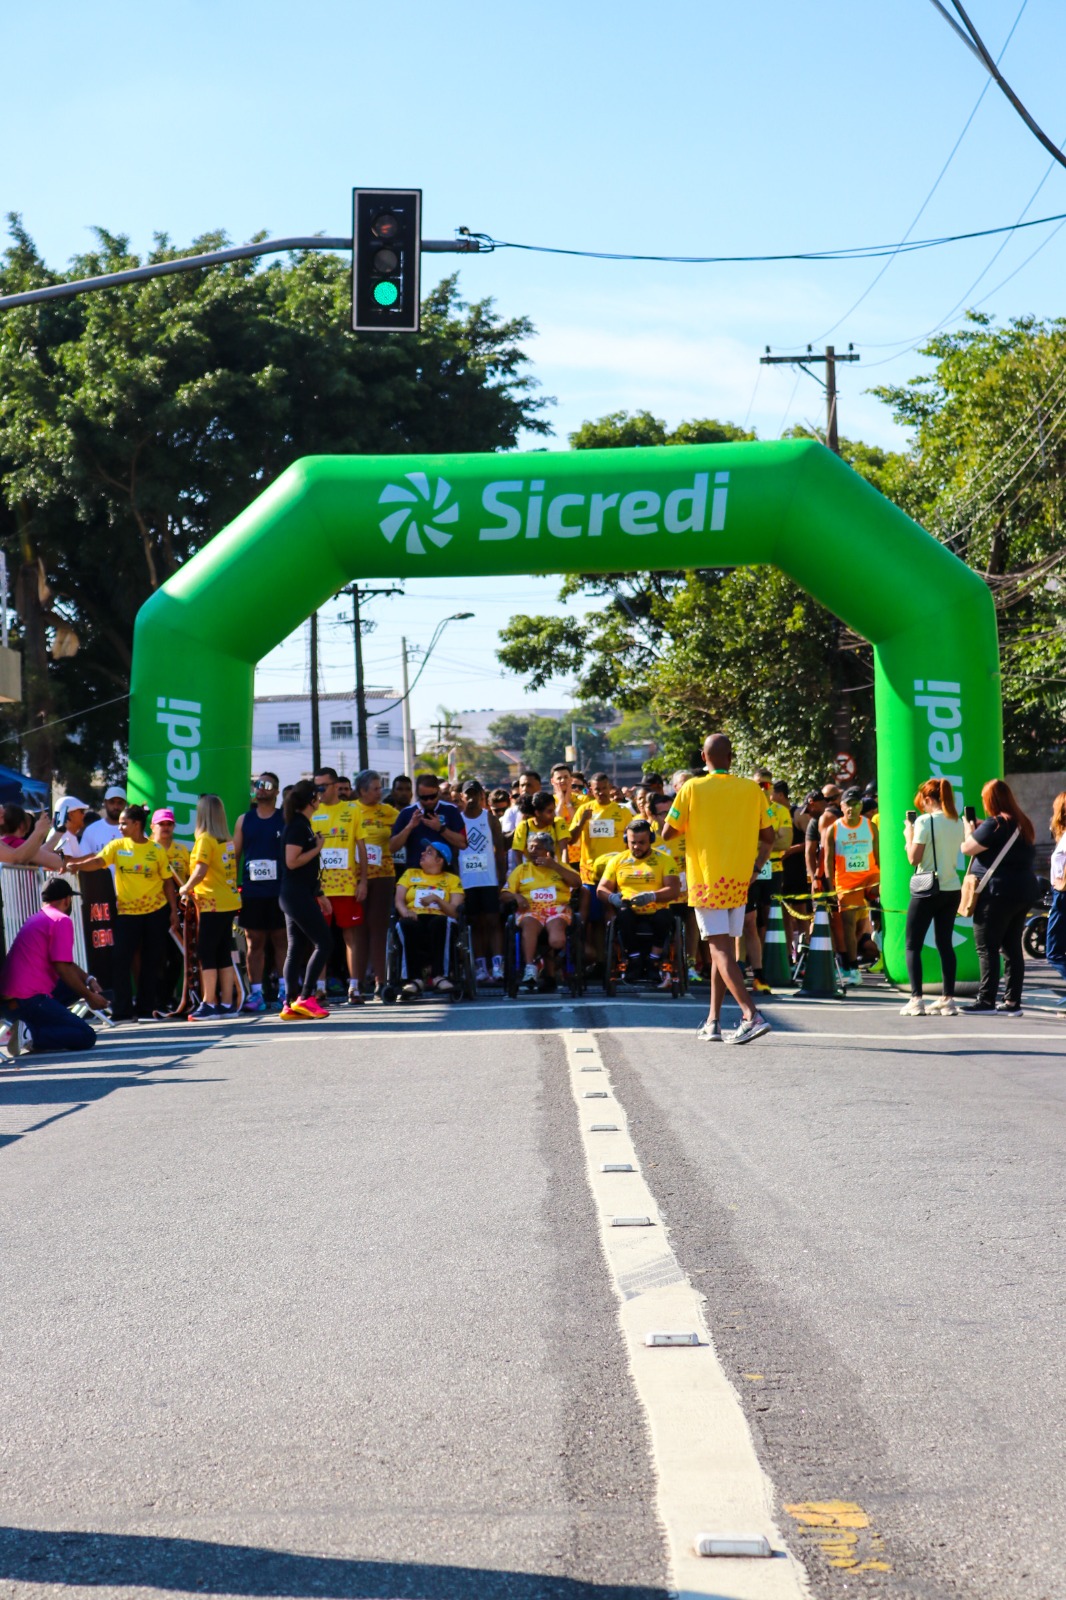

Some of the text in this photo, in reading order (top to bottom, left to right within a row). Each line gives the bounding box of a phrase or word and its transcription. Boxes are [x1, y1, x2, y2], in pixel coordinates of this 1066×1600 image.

[479, 471, 730, 541] Sicredi
[323, 857, 342, 865] 6067
[848, 861, 865, 869] 6422
[253, 868, 271, 876] 6061
